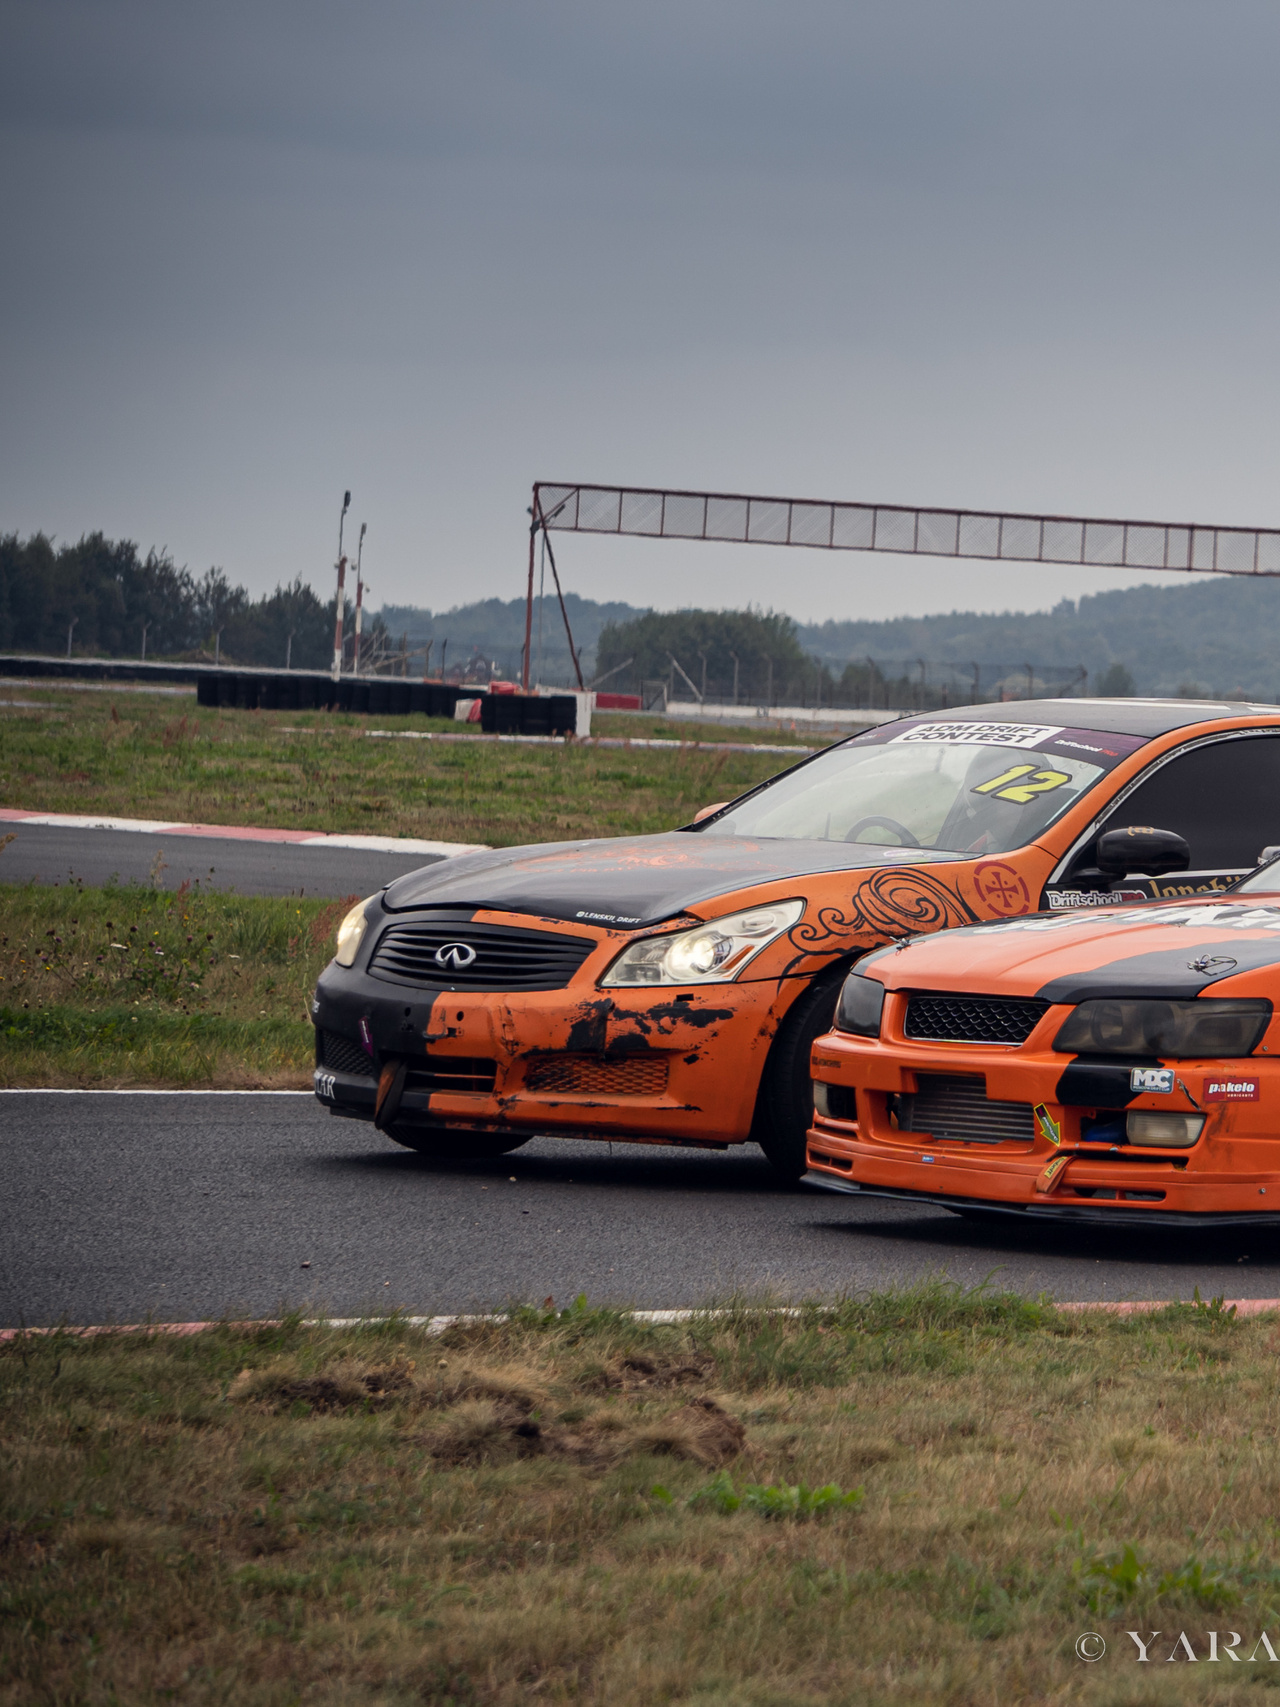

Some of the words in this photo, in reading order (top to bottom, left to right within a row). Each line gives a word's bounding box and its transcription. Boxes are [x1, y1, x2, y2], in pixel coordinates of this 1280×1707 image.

[972, 725, 1049, 736] DRIFT
[902, 732, 1037, 744] CONTEST
[970, 763, 1073, 806] 12
[1133, 1070, 1171, 1088] MDC
[1208, 1082, 1255, 1094] pakelo
